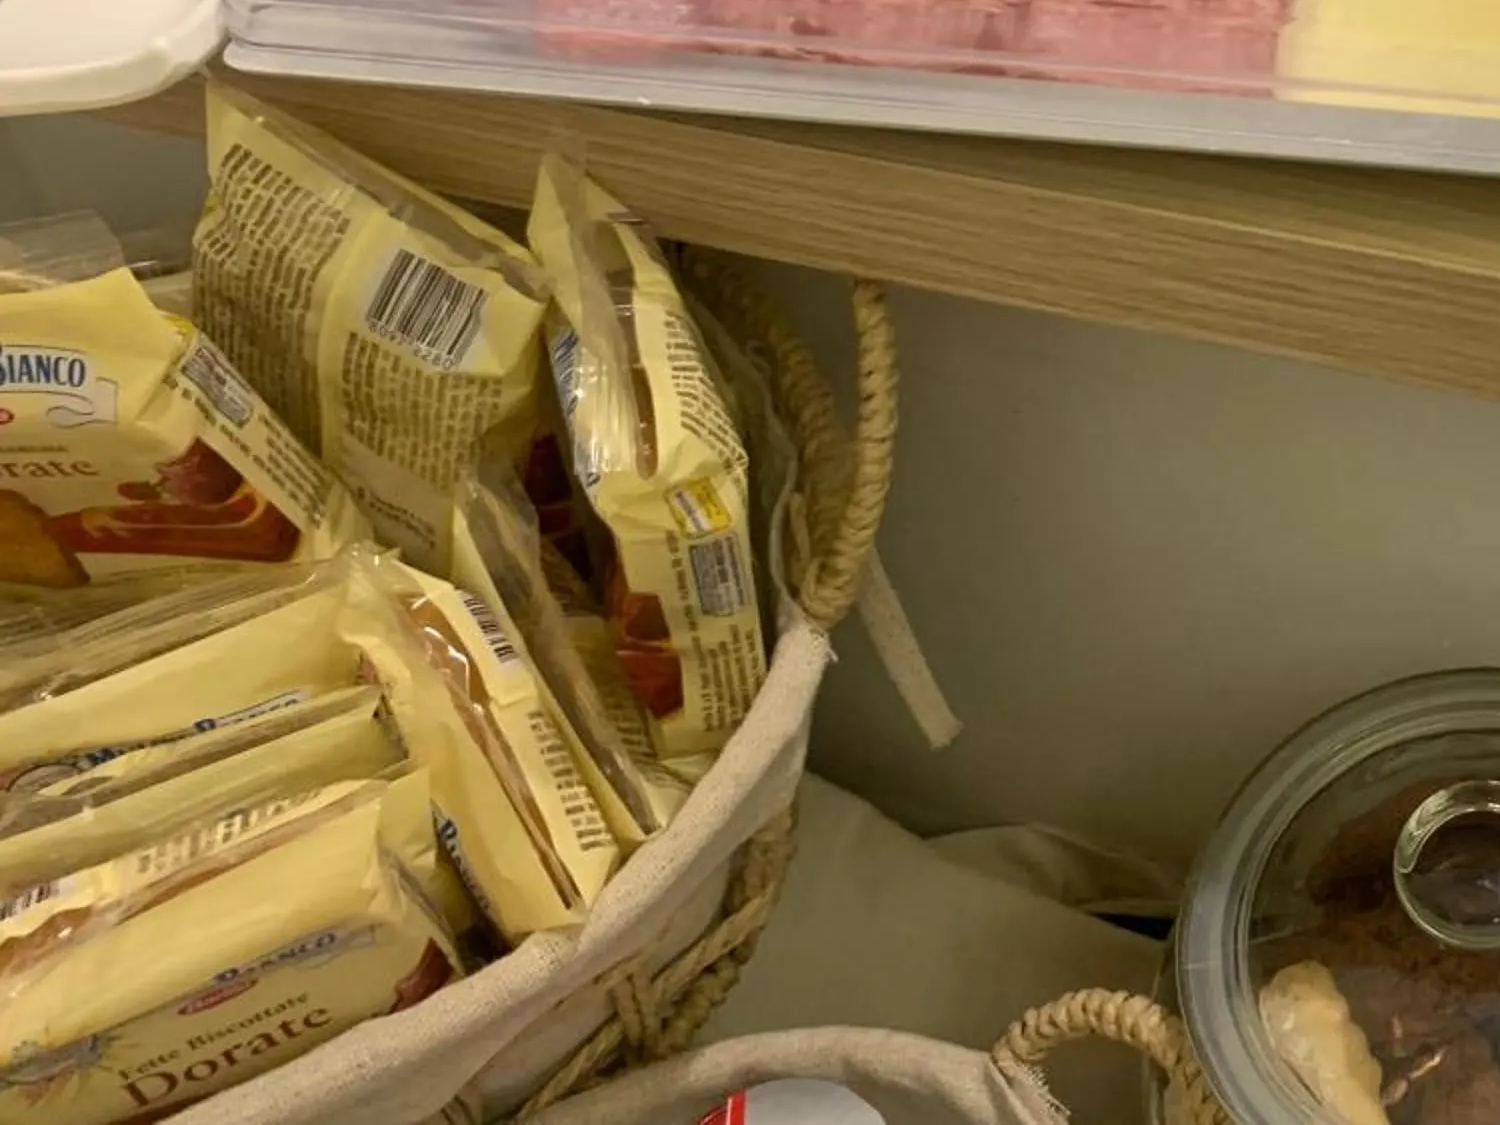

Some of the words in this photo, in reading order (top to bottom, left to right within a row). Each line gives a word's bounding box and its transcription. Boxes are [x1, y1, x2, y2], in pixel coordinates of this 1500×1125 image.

[0, 460, 101, 479] rate
[186, 991, 309, 1051] Biscottate
[120, 1007, 334, 1109] Dorate
